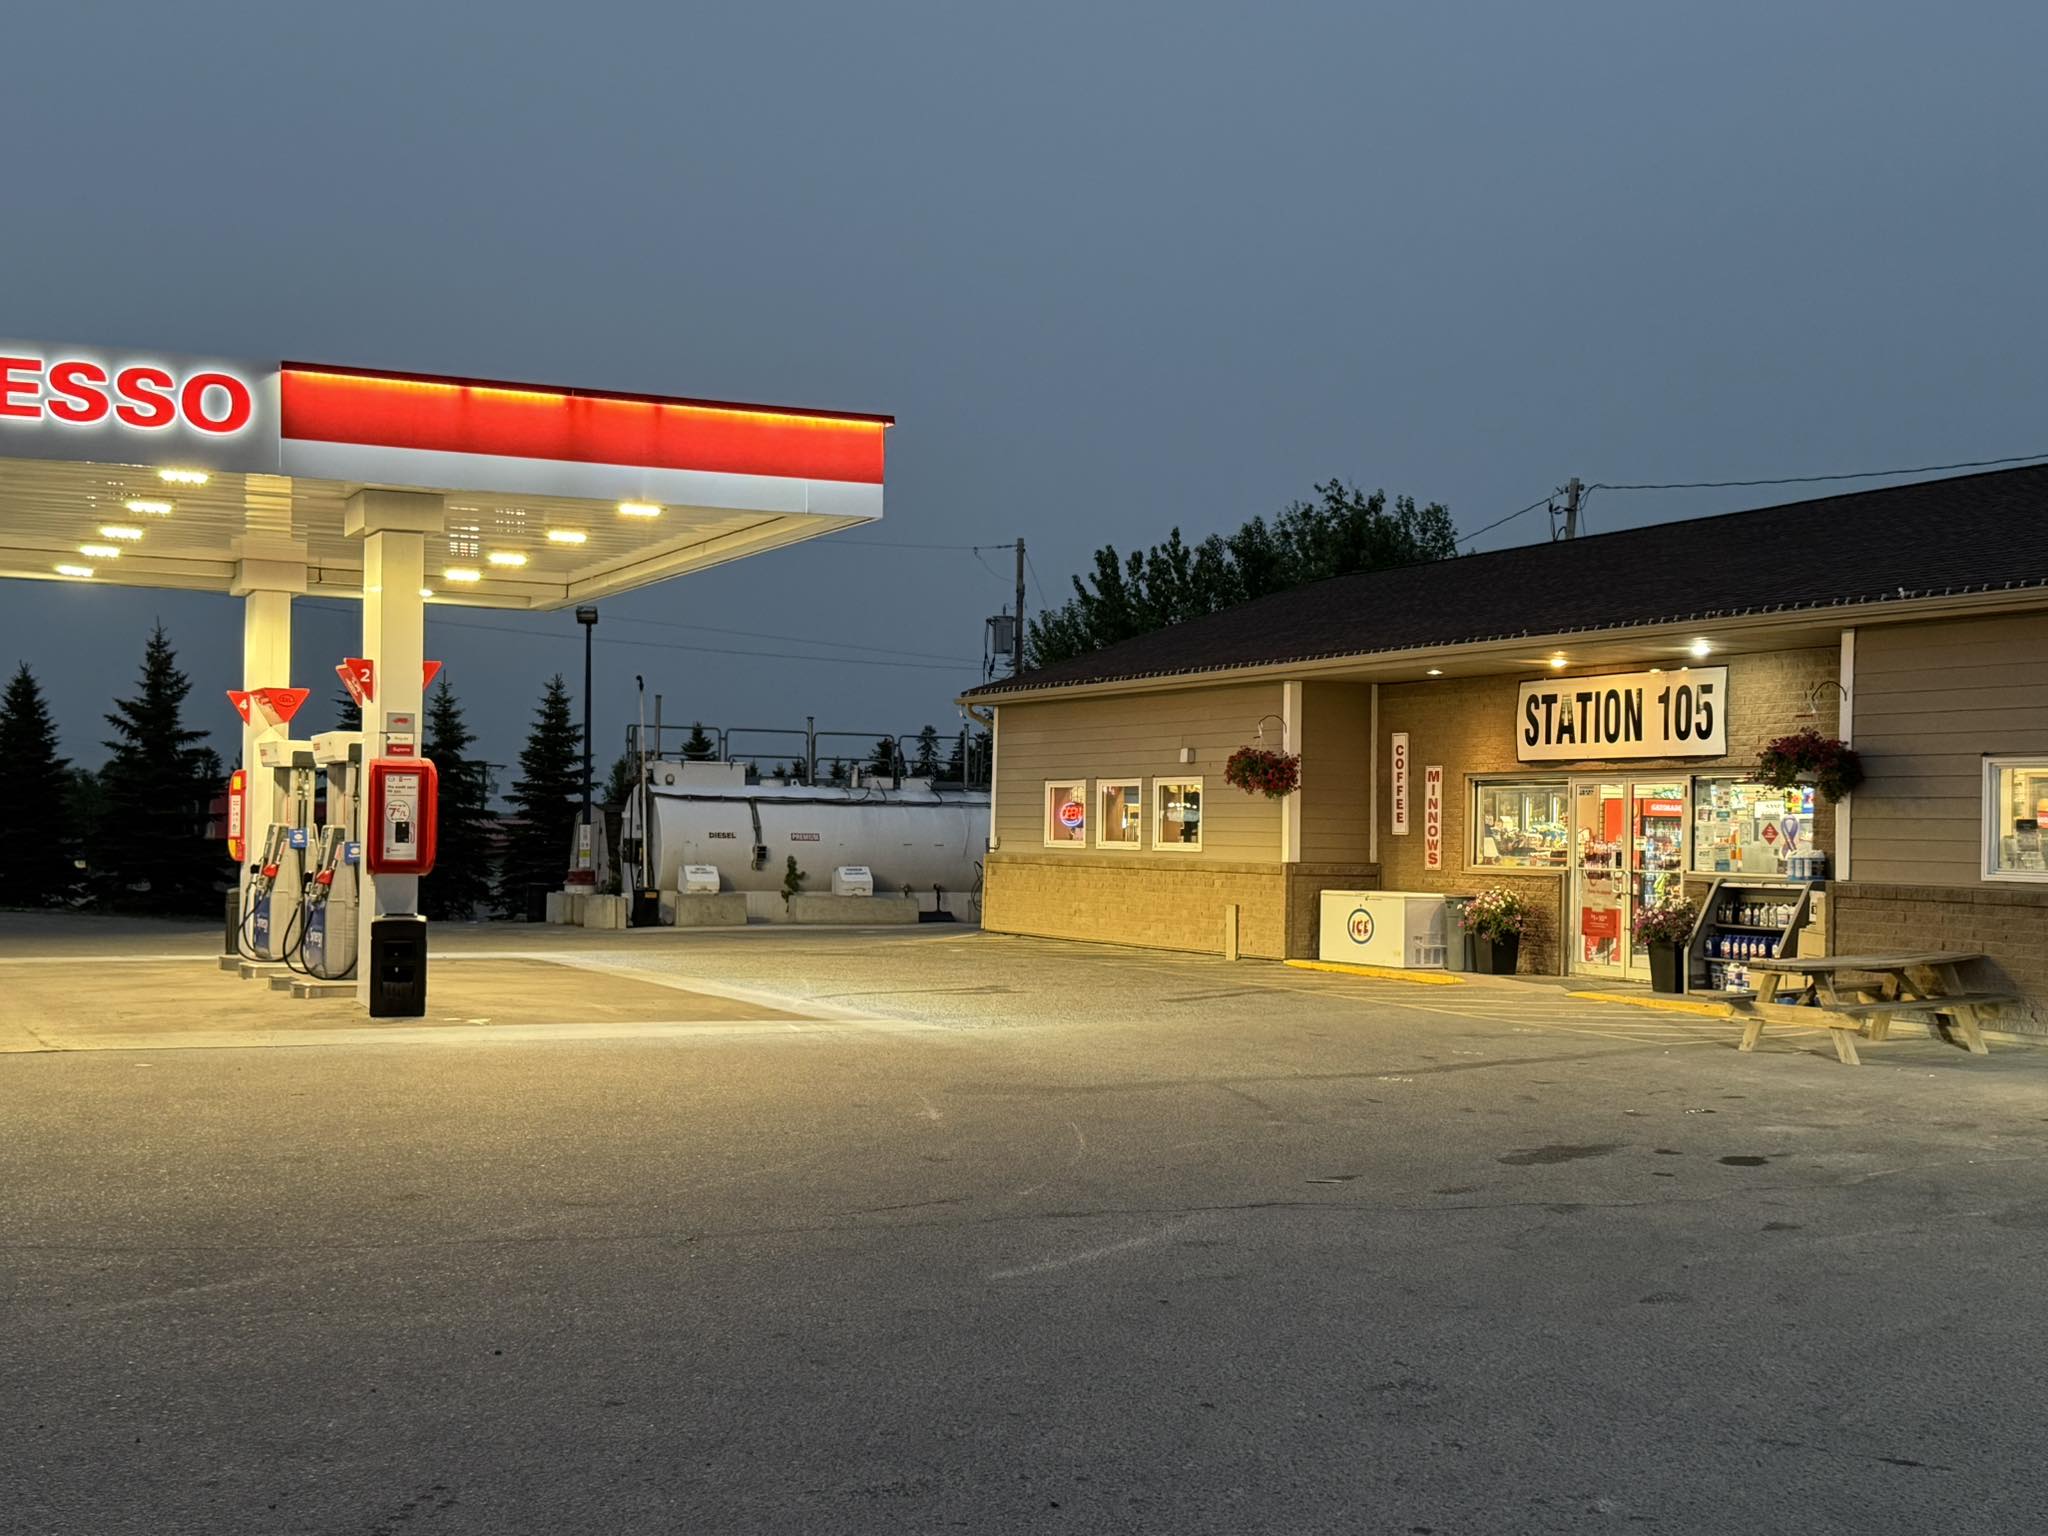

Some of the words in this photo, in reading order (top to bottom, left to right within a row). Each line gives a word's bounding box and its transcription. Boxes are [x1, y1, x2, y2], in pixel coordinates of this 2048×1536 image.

[0, 356, 252, 435] ESSO
[239, 698, 248, 710] 4
[360, 668, 370, 682] 2
[1525, 686, 1643, 746] STATION
[1658, 683, 1714, 742] 105
[1395, 745, 1404, 823] COFFEE
[1427, 770, 1440, 865] MINNOWS
[1351, 919, 1370, 936] ICE
